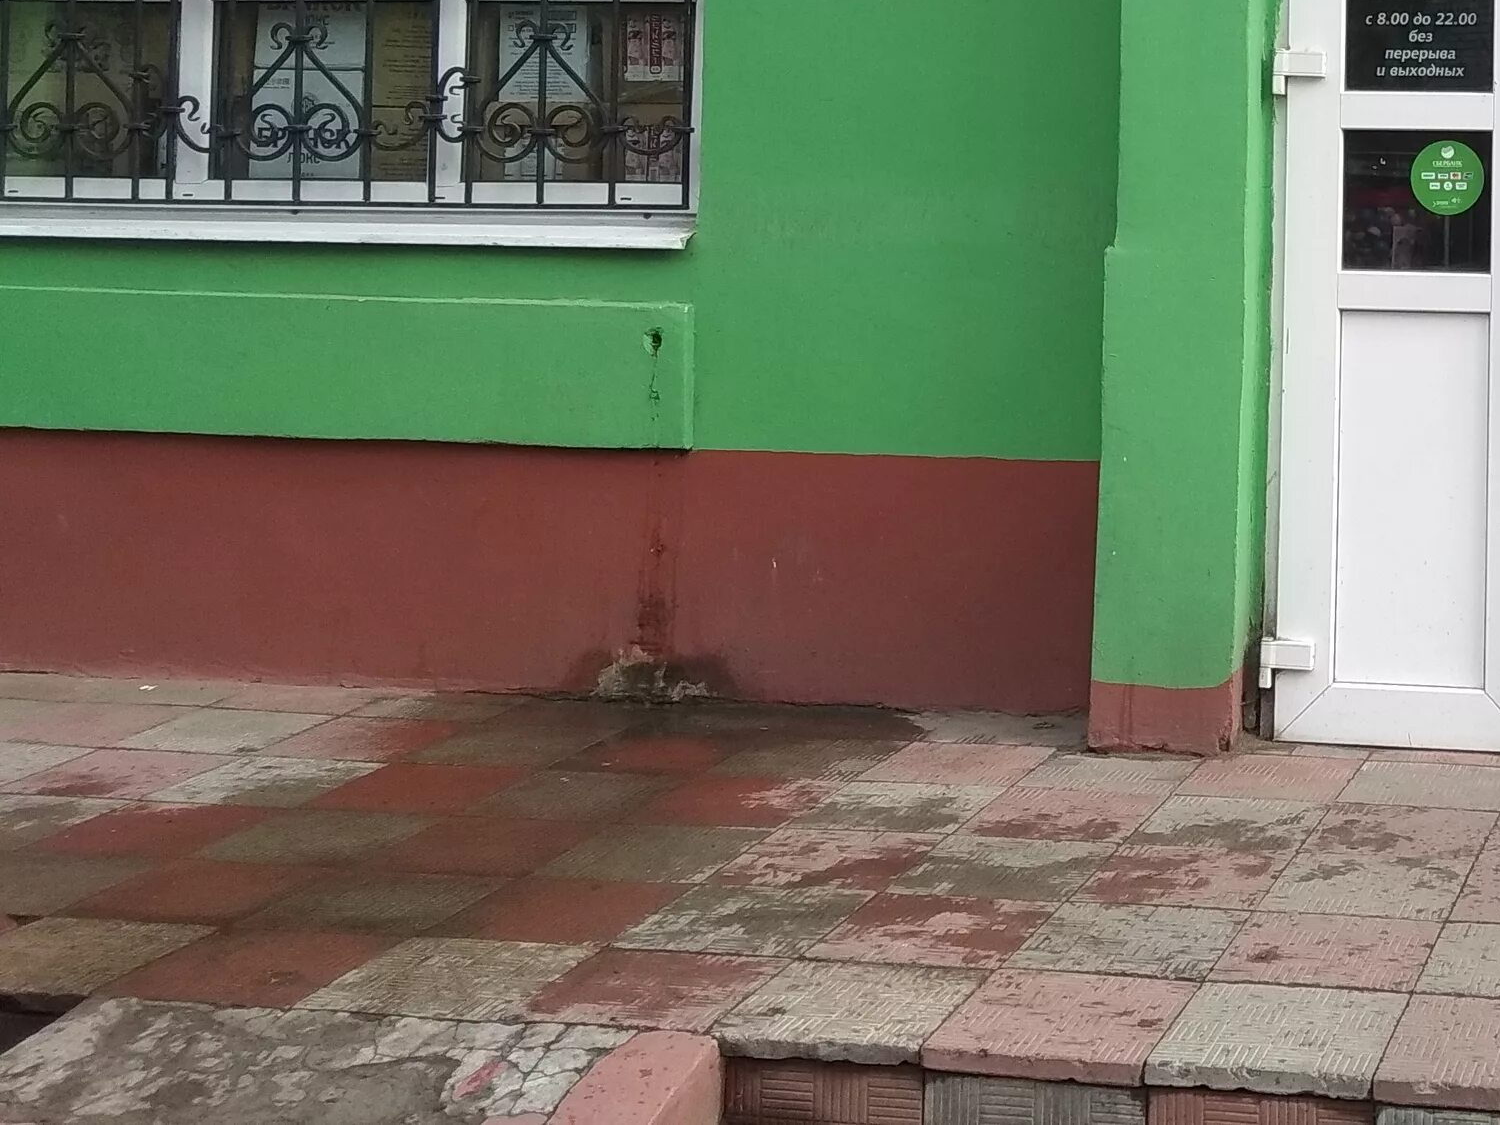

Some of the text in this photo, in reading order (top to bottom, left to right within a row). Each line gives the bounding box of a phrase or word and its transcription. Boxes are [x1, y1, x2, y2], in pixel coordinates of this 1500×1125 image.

[1365, 12, 1478, 26] с 8.00 до 22.00
[1408, 29, 1433, 43] без
[1384, 49, 1456, 63] перерыва
[1376, 63, 1465, 77] и выходных
